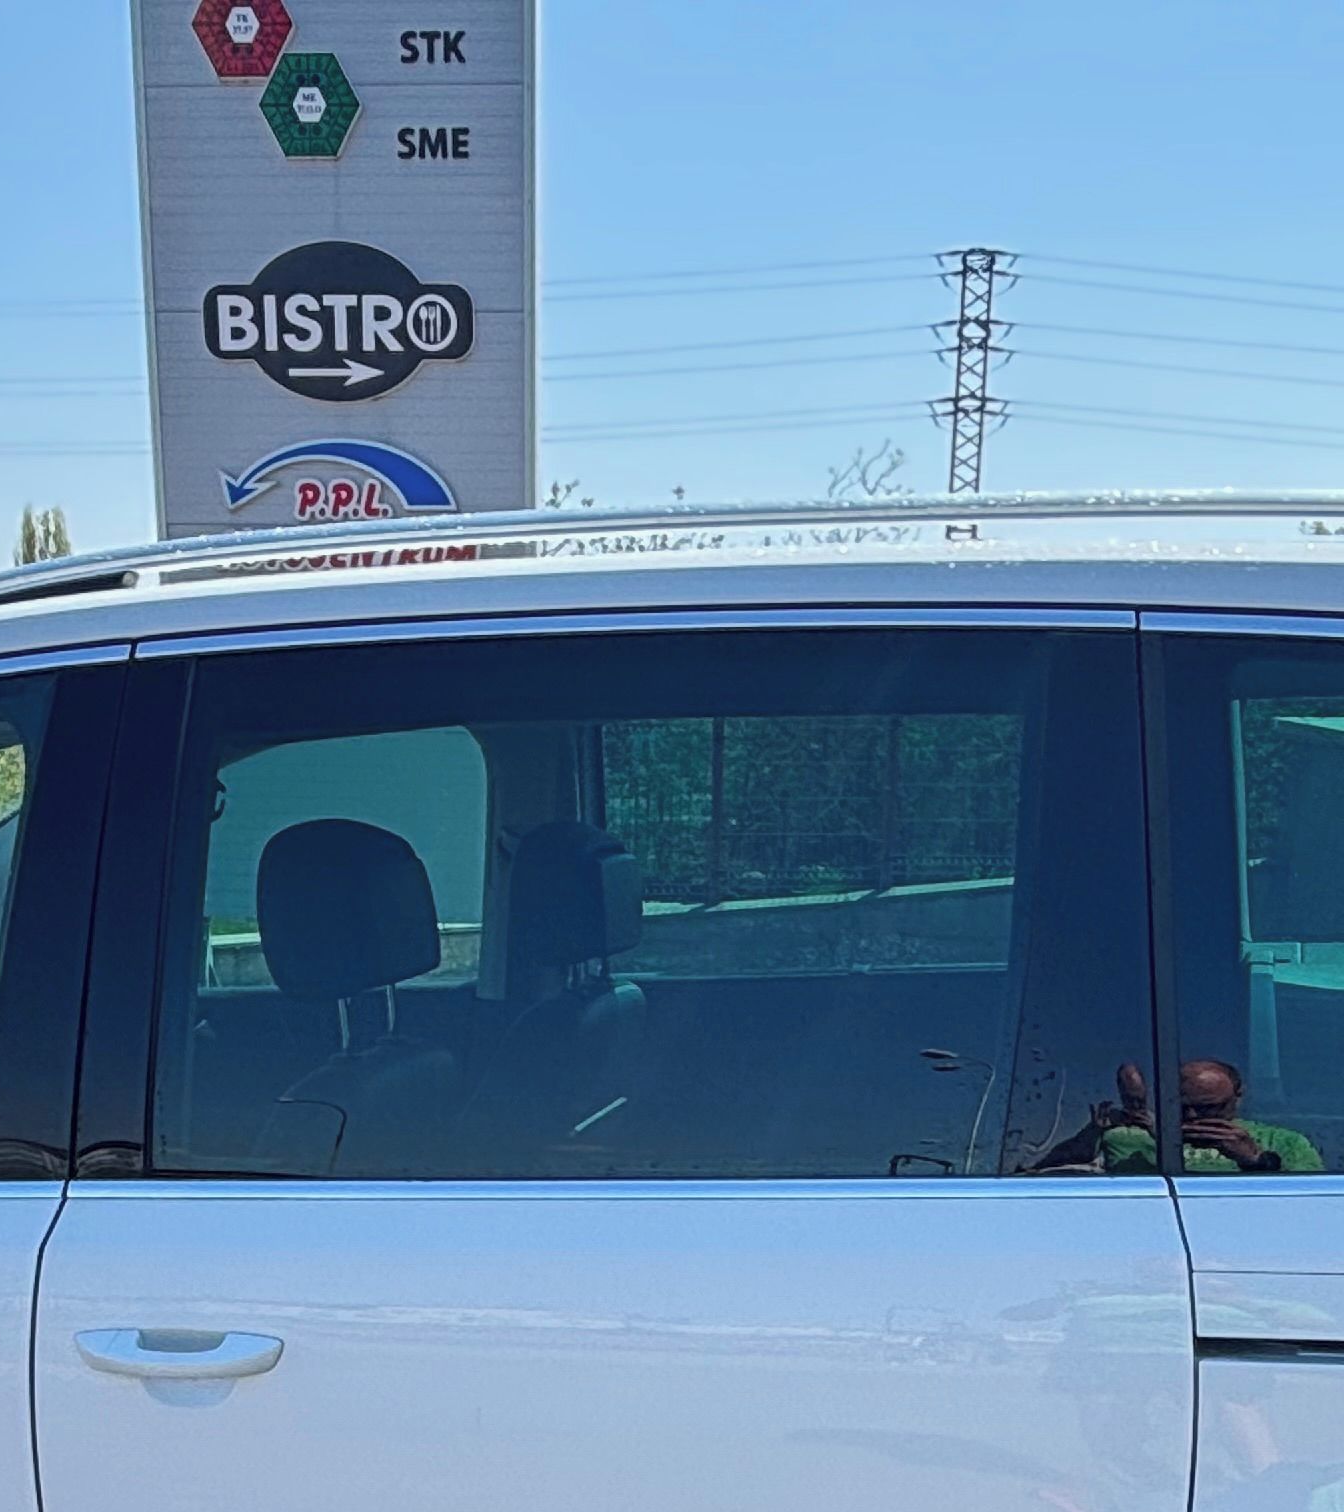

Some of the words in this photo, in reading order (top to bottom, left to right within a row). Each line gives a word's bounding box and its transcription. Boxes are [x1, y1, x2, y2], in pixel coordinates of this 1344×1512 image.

[399, 30, 466, 64] STK
[397, 126, 470, 160] SME
[216, 293, 457, 352] BISTRO
[297, 481, 391, 518] P.P.L.
